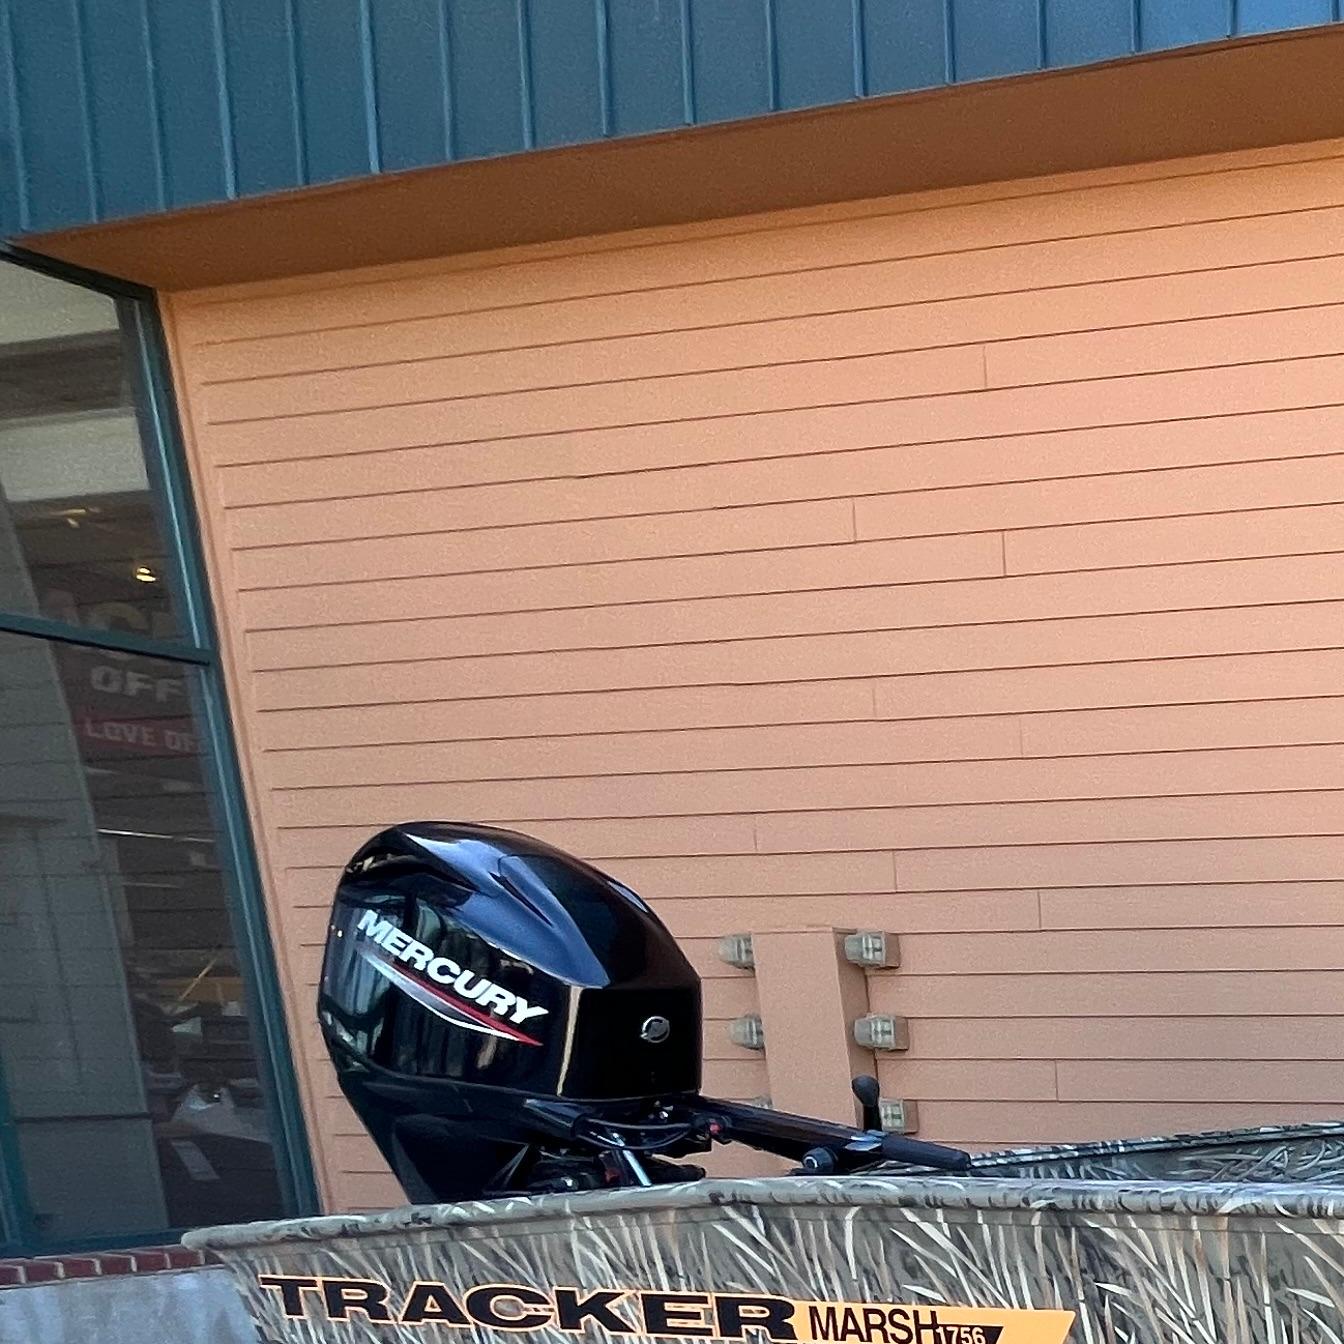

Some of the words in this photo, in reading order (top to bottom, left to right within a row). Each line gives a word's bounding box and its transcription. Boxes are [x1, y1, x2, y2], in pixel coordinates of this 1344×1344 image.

[91, 665, 186, 702] OFF
[357, 909, 549, 1024] MERCURY
[258, 1274, 801, 1343] TRACKER
